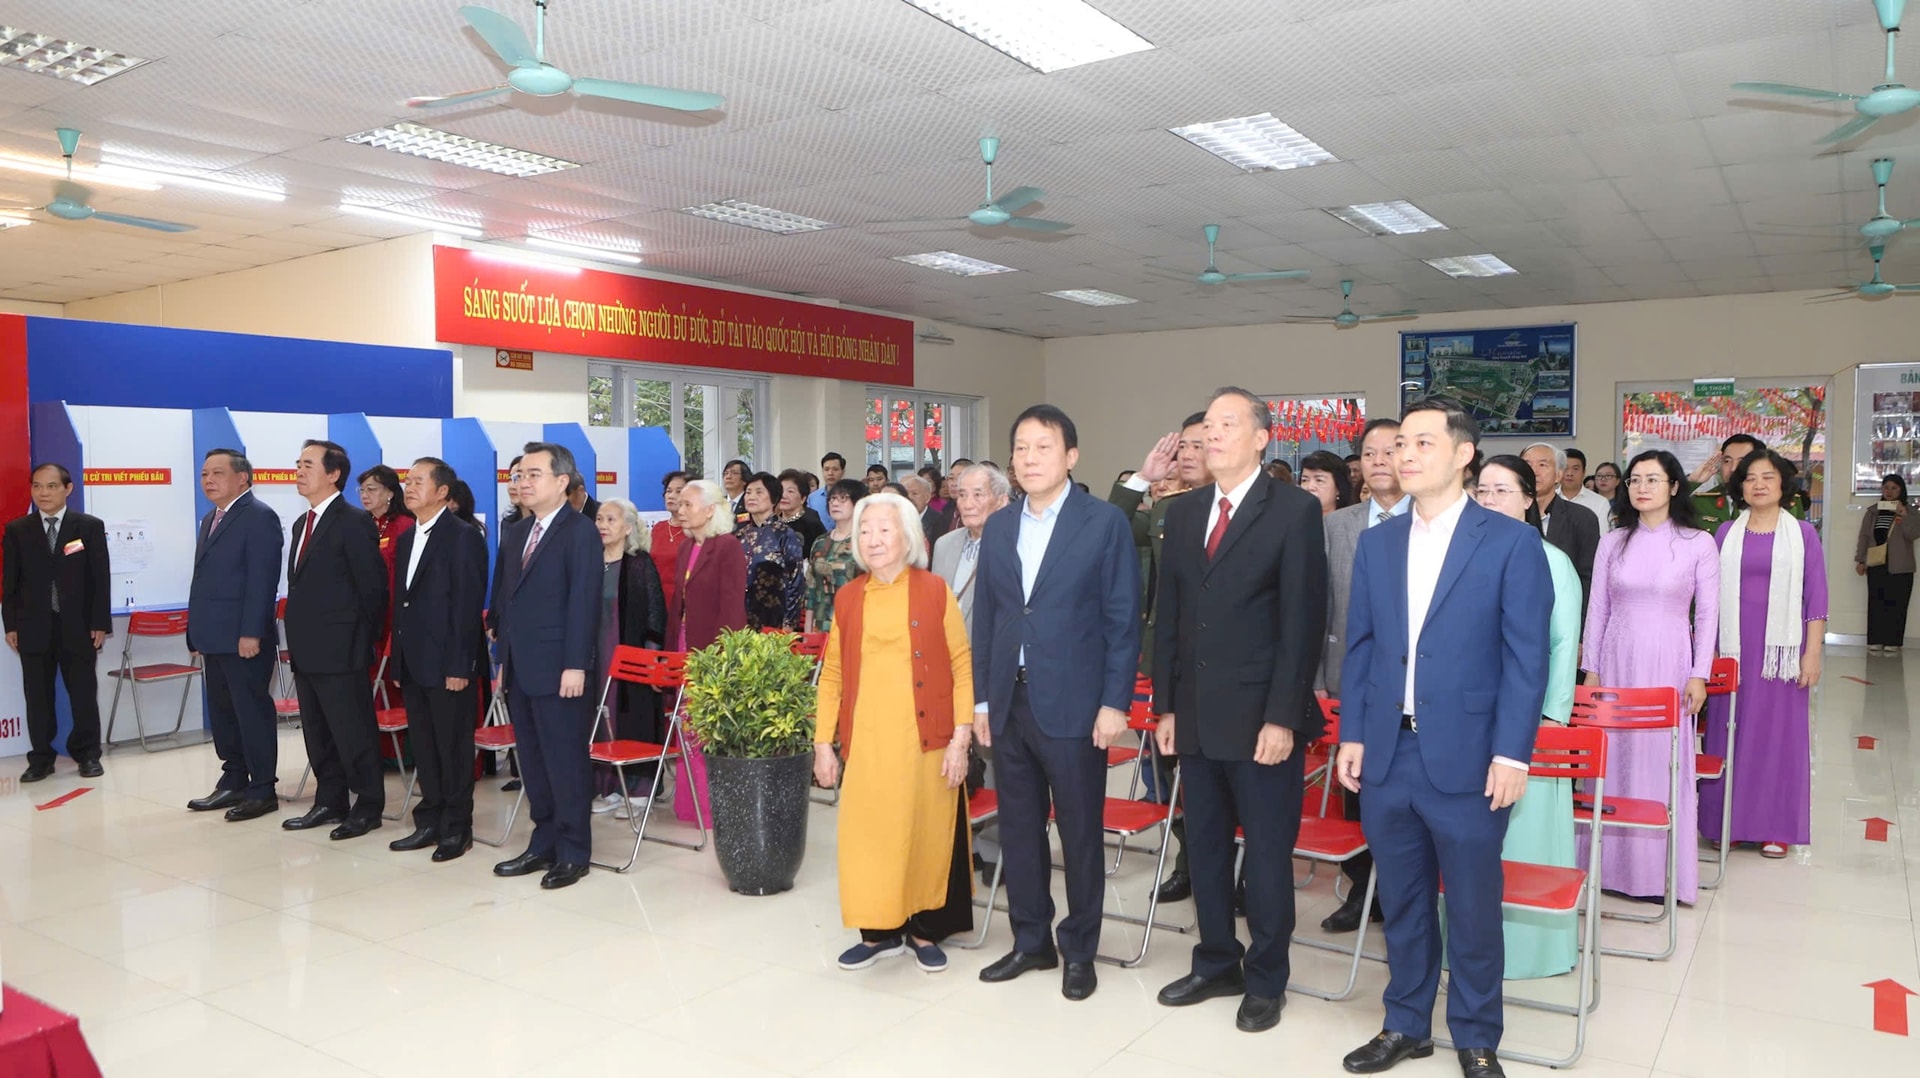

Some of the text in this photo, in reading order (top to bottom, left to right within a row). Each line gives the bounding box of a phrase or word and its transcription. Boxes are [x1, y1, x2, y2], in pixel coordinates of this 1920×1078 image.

[464, 277, 500, 320] SÁNG
[502, 279, 535, 324] SUỐT
[537, 292, 561, 334] LỰA
[563, 299, 595, 337] CHỌN
[598, 299, 637, 336] NHỮNG
[639, 303, 671, 340] NGƯỜI
[673, 302, 688, 341] ĐỦ
[689, 309, 711, 348] ĐỨC,
[712, 307, 726, 346] ĐỦ
[727, 314, 743, 347] TÀI
[745, 316, 764, 350] VÀO
[765, 316, 789, 352] QUỐC
[790, 322, 805, 361] HỘI
[807, 325, 819, 357] VÀ
[820, 326, 834, 364] HỘI
[835, 323, 858, 361] ĐỒNG
[858, 333, 880, 363] NHÂN
[101, 473, 113, 481] TRI
[113, 471, 128, 481] VIẾT
[129, 470, 149, 481] PHIẾU
